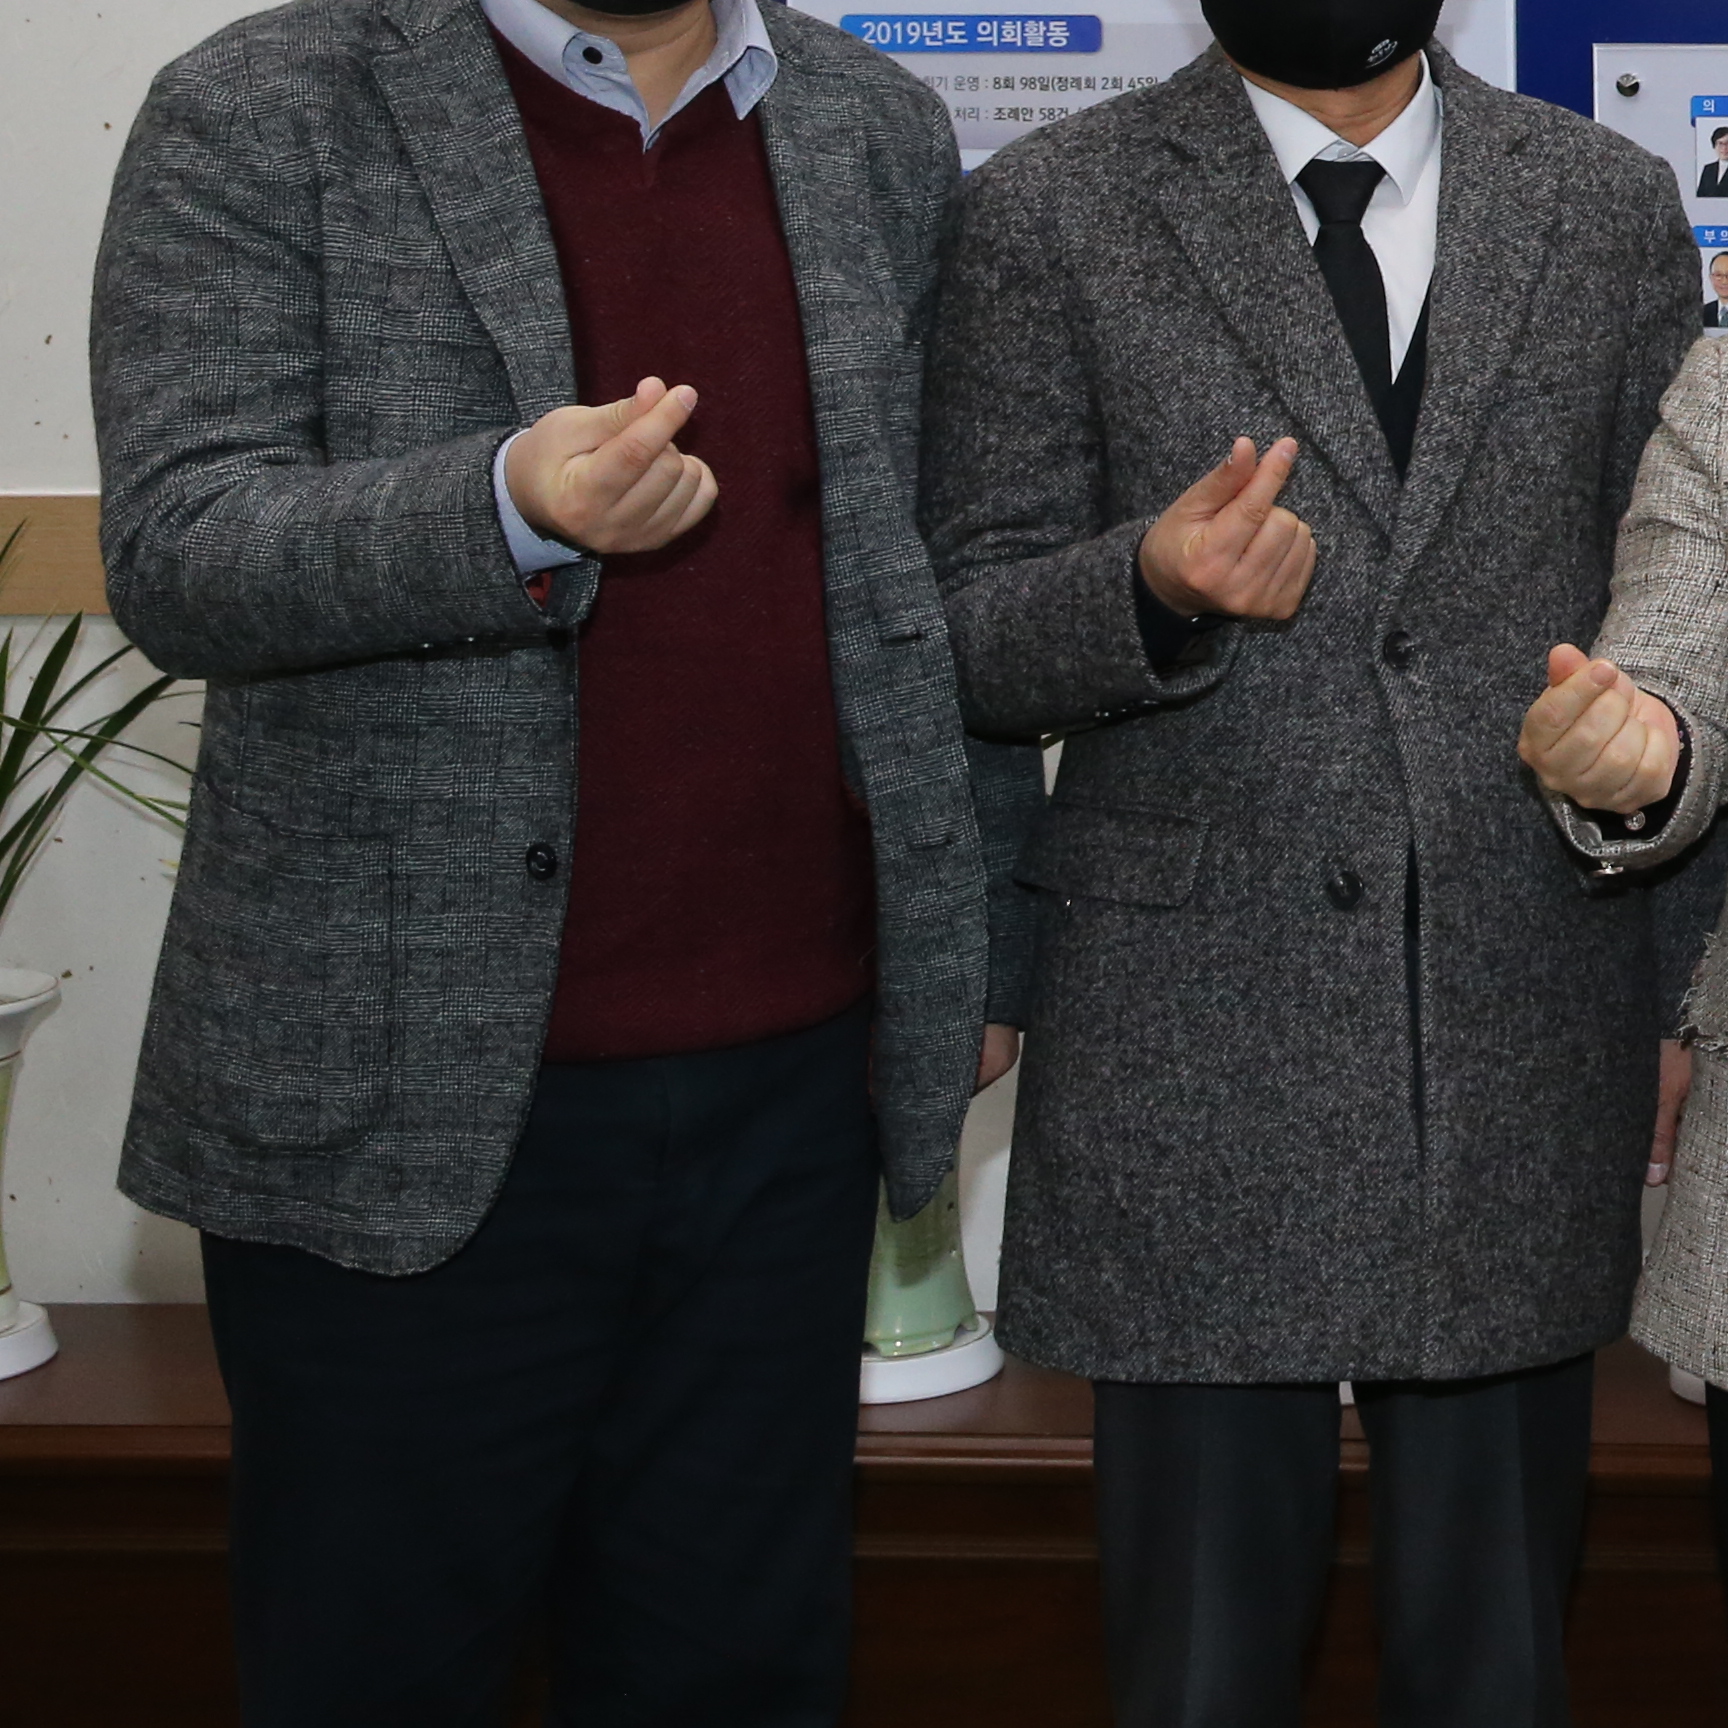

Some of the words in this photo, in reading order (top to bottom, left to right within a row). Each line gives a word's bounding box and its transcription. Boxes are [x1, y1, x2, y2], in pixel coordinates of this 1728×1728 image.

[861, 21, 968, 47] 2019년도
[977, 21, 1069, 47] 의회활동
[954, 77, 979, 91] 운영
[993, 77, 1014, 91] 8회
[1101, 77, 1122, 91] 2회
[954, 108, 979, 122] 처리
[993, 108, 1033, 122] 조례안
